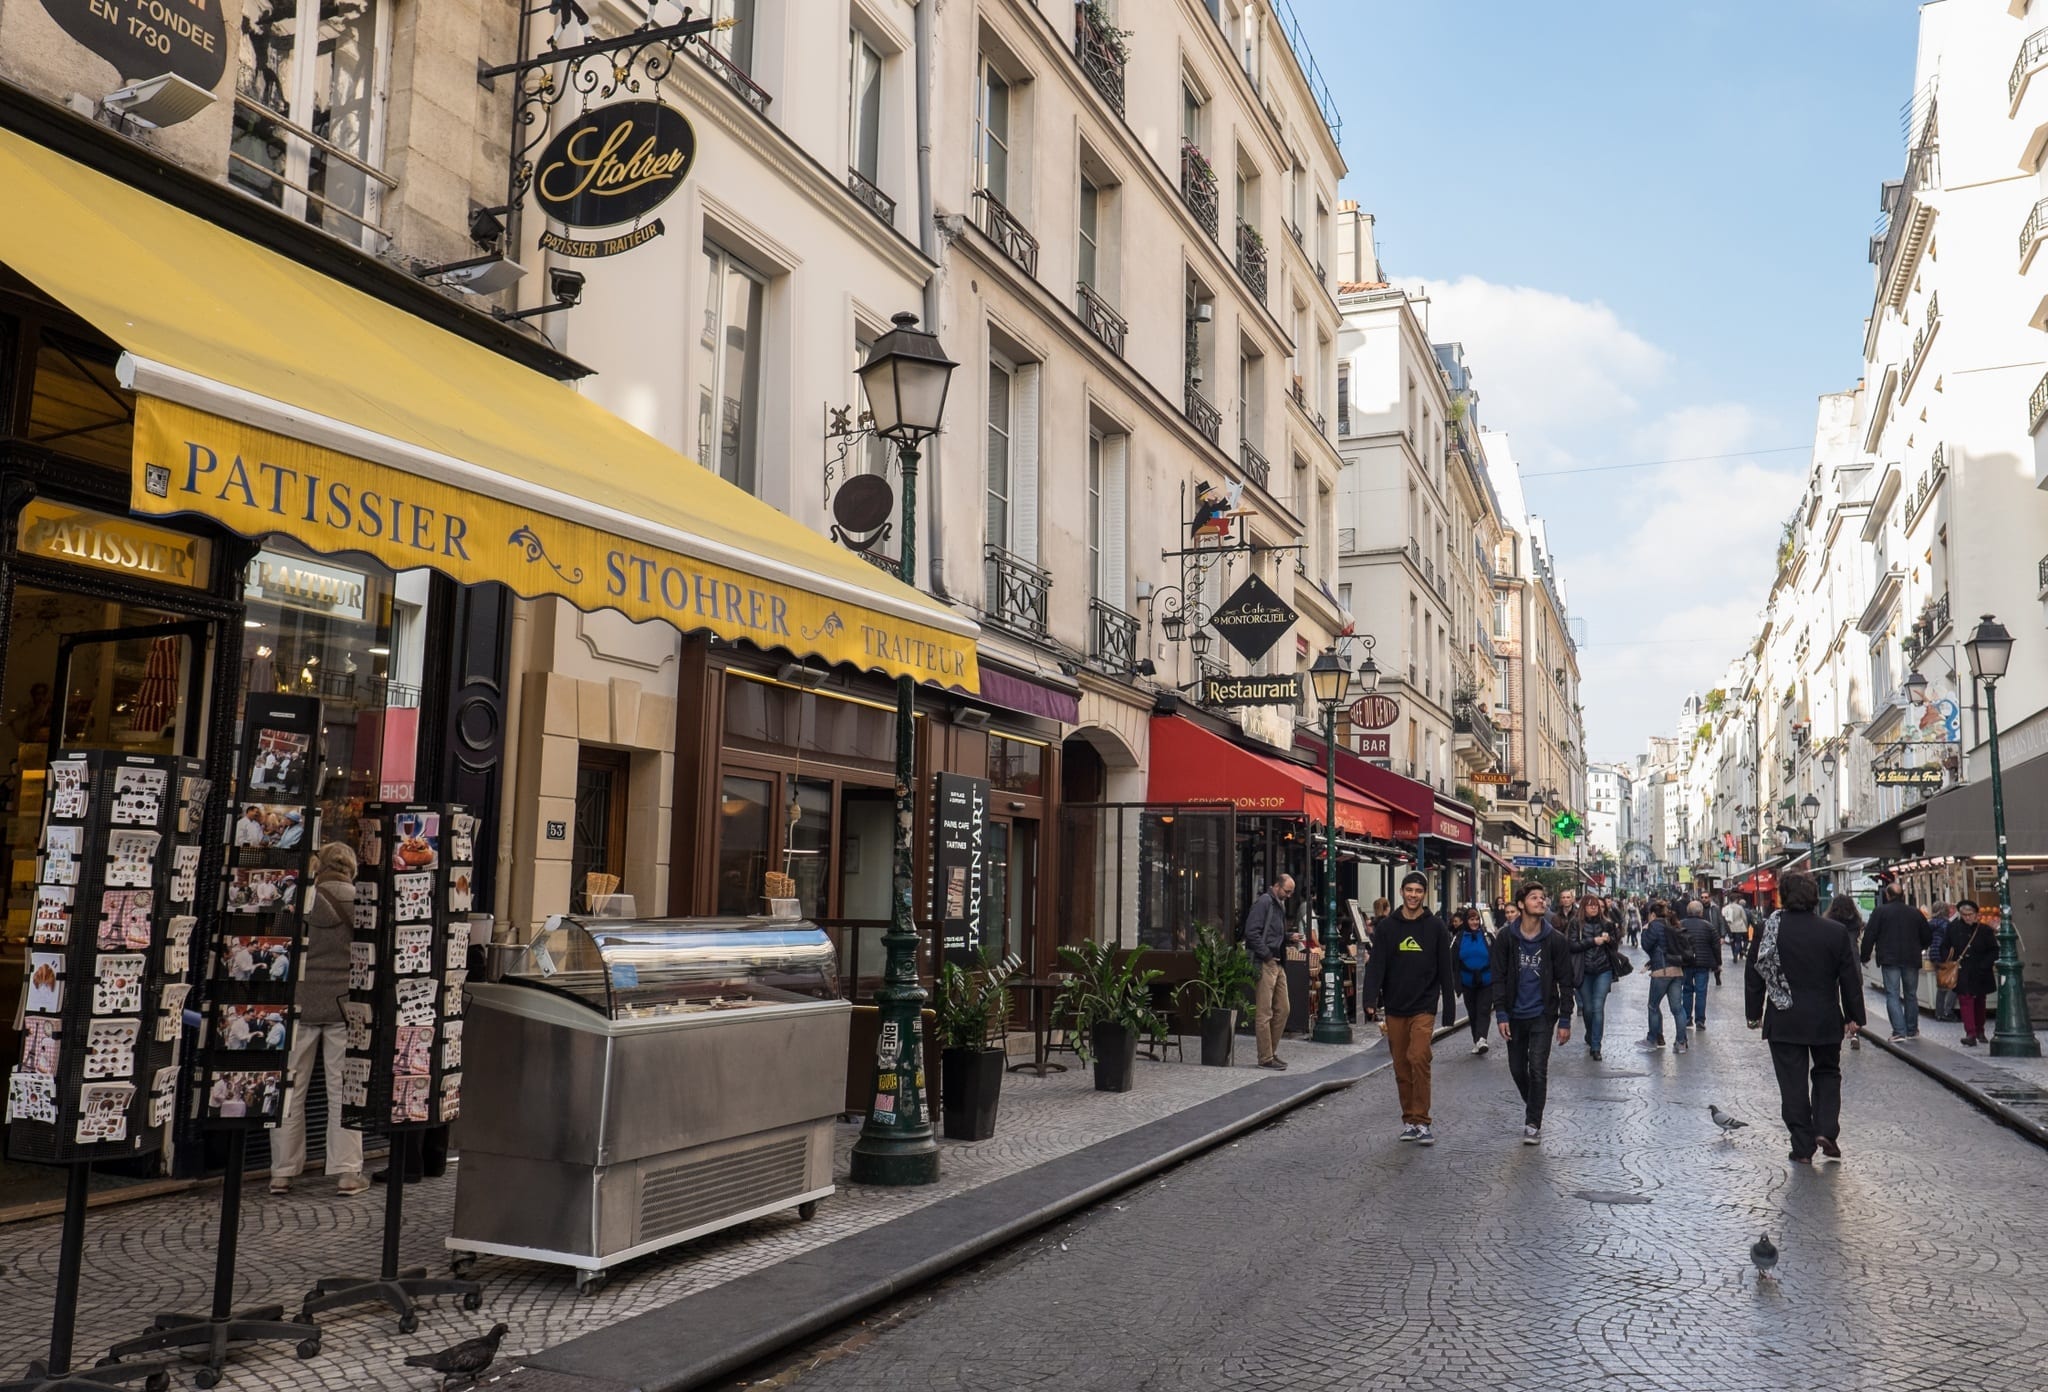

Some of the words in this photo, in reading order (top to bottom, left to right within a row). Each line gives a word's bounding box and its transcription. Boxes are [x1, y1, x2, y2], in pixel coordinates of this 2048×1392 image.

[89, 0, 119, 25] EN
[127, 16, 171, 55] 1730
[540, 120, 686, 202] Stohrer
[543, 234, 598, 257] PATISSIER
[603, 223, 657, 255] TRAITEUR
[34, 515, 187, 578] PATISSIER
[178, 440, 471, 561] PATISSIER
[605, 550, 790, 637] STOHRER
[860, 624, 966, 678] TRAITEUR
[244, 559, 362, 610] TRAITEUR
[1220, 613, 1287, 625] MONTORGUEIL
[1210, 679, 1298, 703] Restaurant
[1362, 739, 1386, 752] BAR
[1474, 774, 1508, 783] NICOLAS
[550, 824, 563, 837] 53
